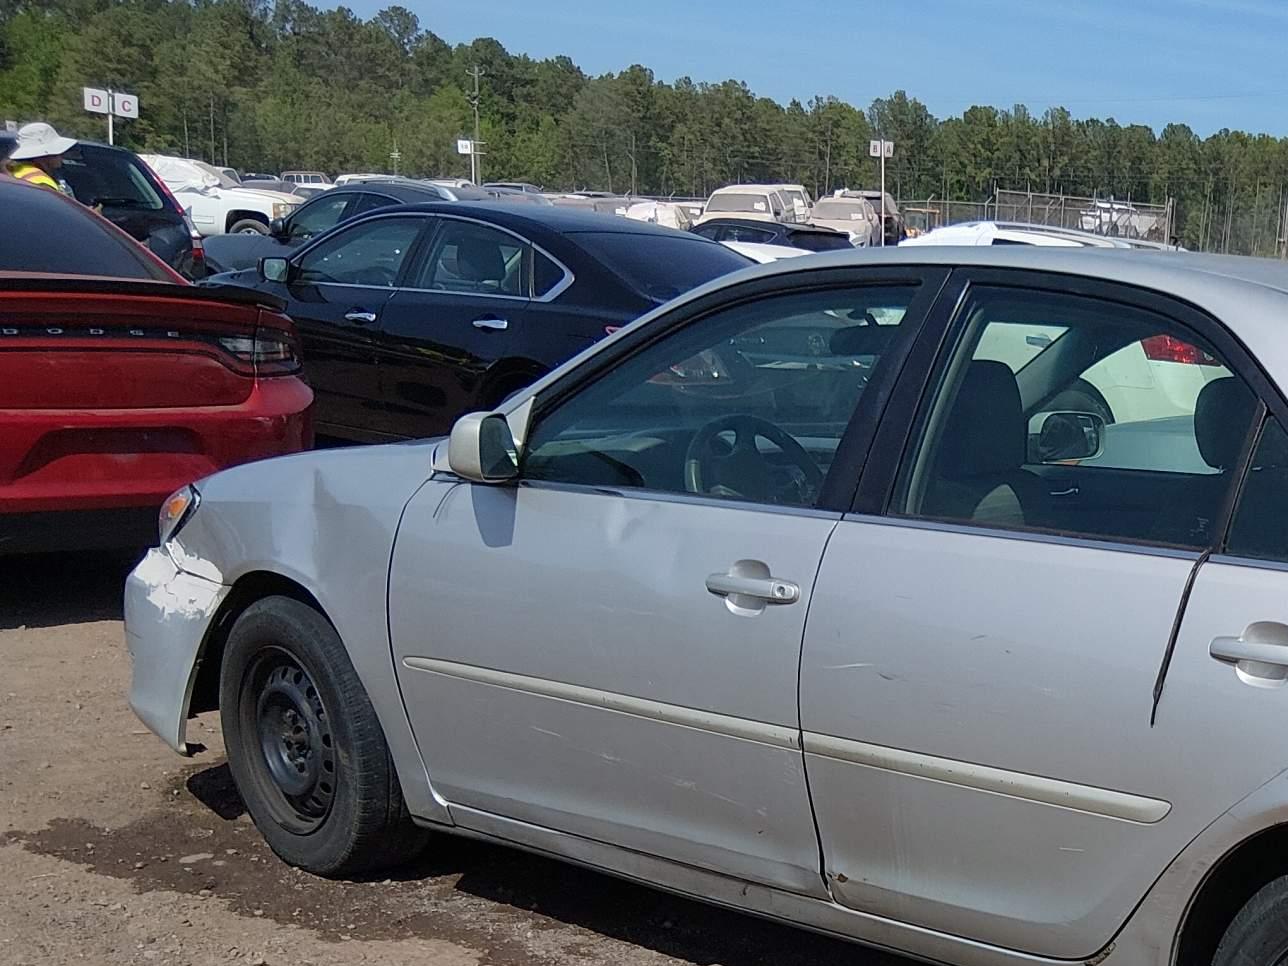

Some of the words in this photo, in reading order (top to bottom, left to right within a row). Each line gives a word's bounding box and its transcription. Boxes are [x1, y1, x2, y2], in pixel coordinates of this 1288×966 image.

[91, 95, 102, 107] D
[121, 100, 132, 112] C
[886, 145, 892, 154] A
[2, 328, 180, 338] DODGE
